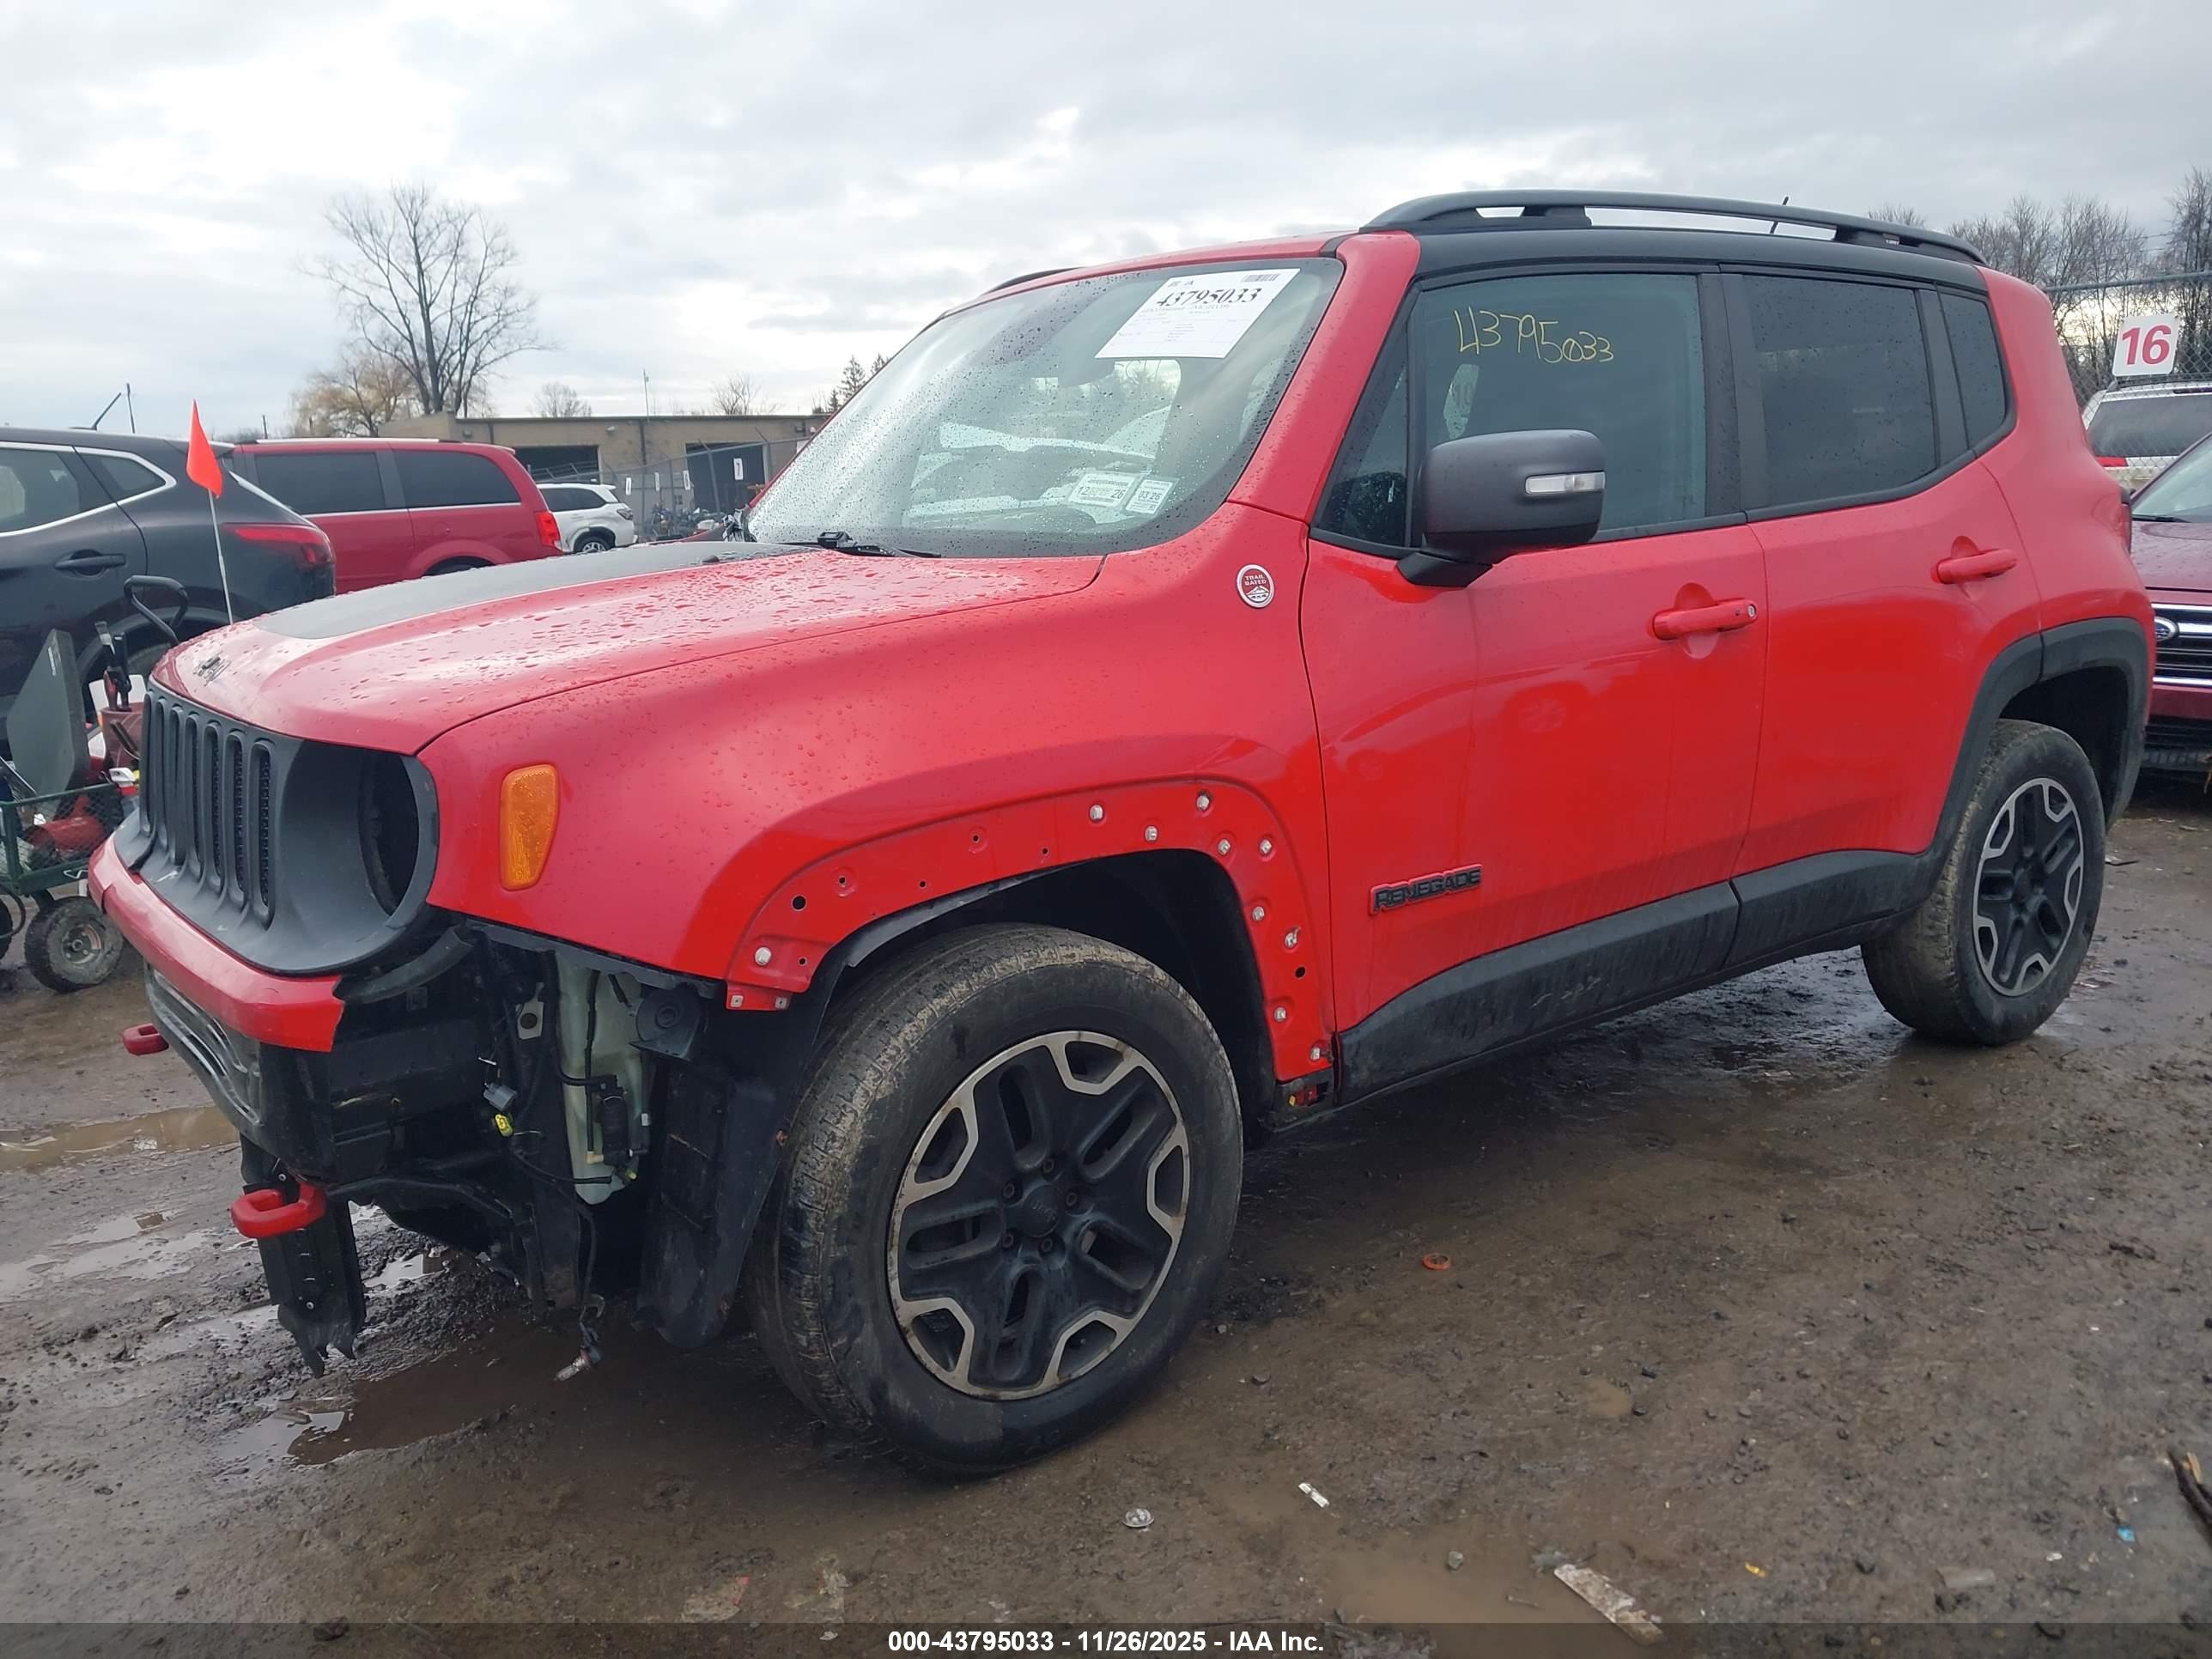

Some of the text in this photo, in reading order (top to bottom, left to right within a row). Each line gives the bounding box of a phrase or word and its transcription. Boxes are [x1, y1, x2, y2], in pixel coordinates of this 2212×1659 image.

[1157, 288, 1262, 307] 43795033
[1454, 306, 1614, 363] 43795033
[2122, 325, 2172, 365] 16
[1372, 866, 1482, 913] RENEGADE
